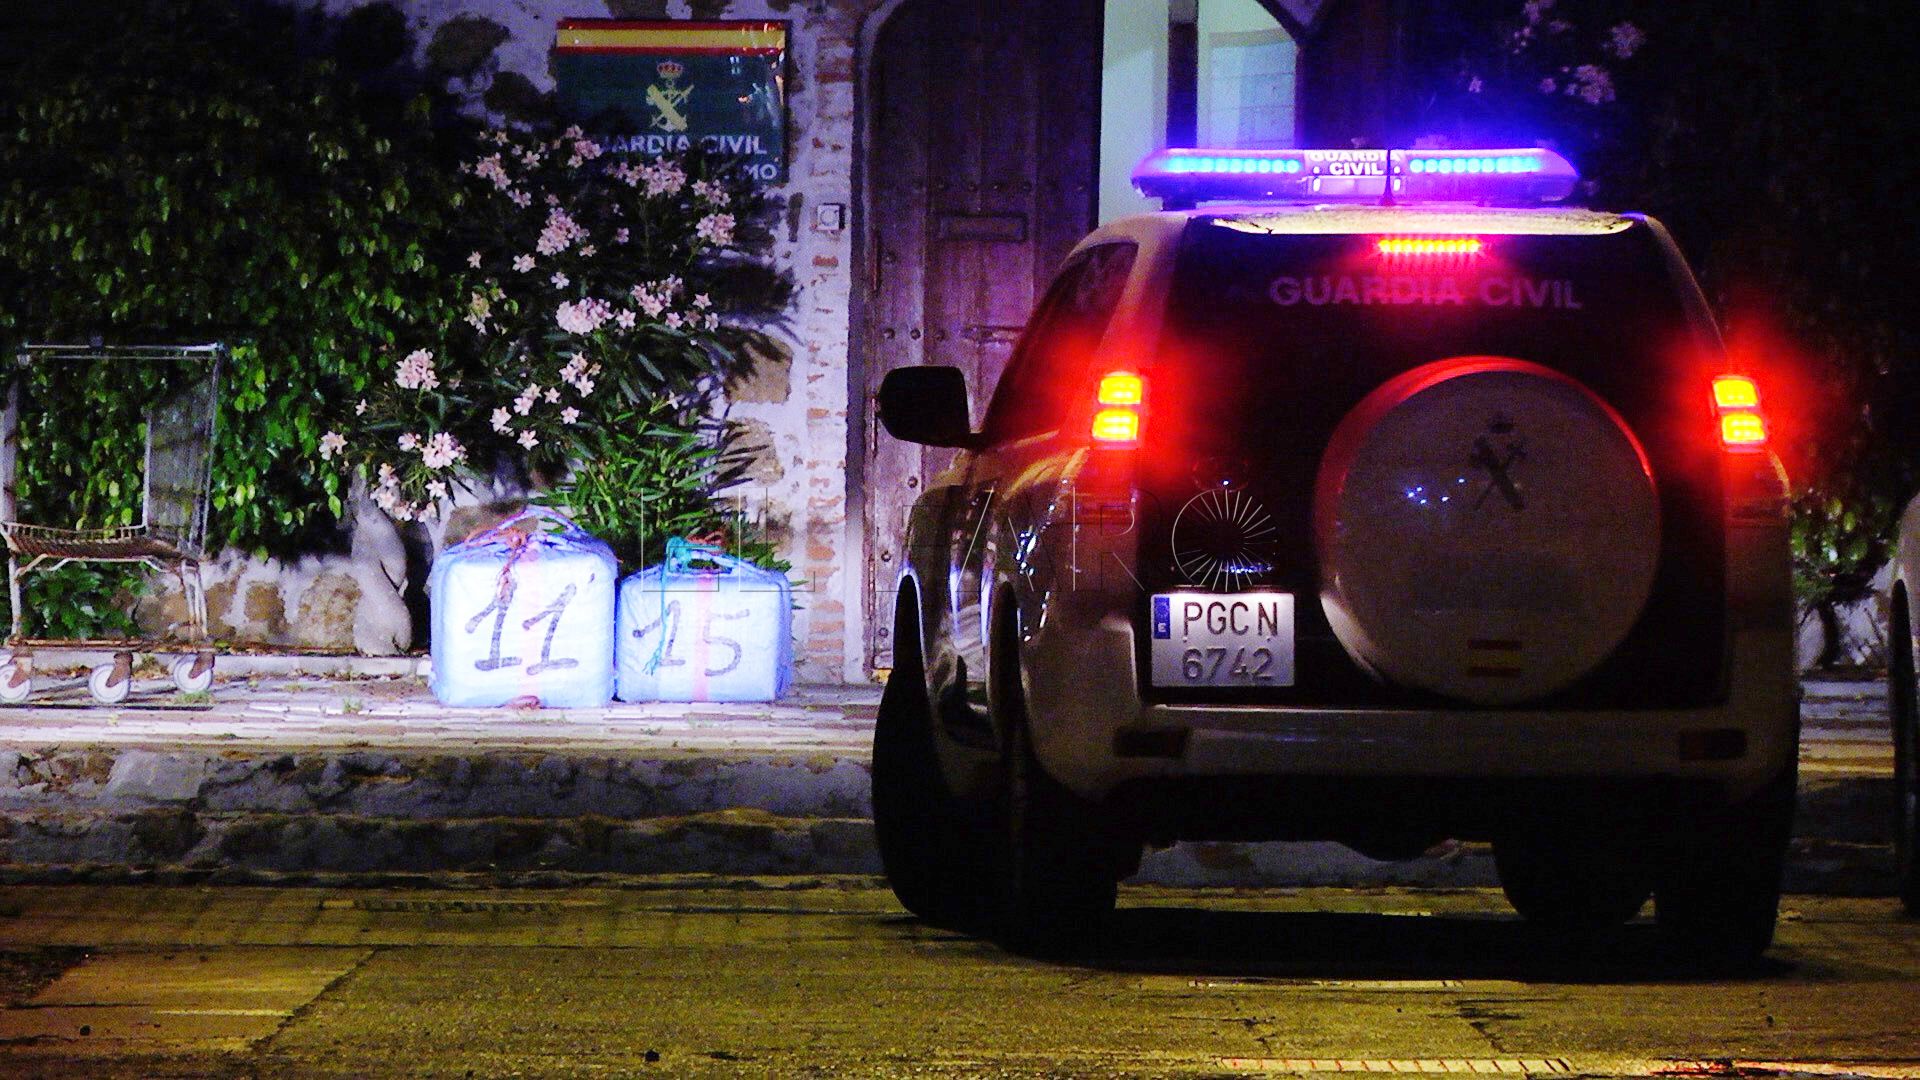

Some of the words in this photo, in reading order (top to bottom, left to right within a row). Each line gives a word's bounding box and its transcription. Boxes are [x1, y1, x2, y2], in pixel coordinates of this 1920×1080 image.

[599, 134, 691, 154] ARDIA
[701, 135, 768, 155] CIVIL
[1308, 149, 1402, 162] GUARDIA
[1329, 162, 1384, 175] CIVIL
[1268, 275, 1465, 306] GUARDIA
[1479, 276, 1583, 310] CIVIL
[464, 577, 580, 676] 11
[1157, 622, 1168, 633] E
[1183, 601, 1279, 637] PGCN
[632, 599, 751, 677] 15
[1182, 647, 1275, 682] 6742
